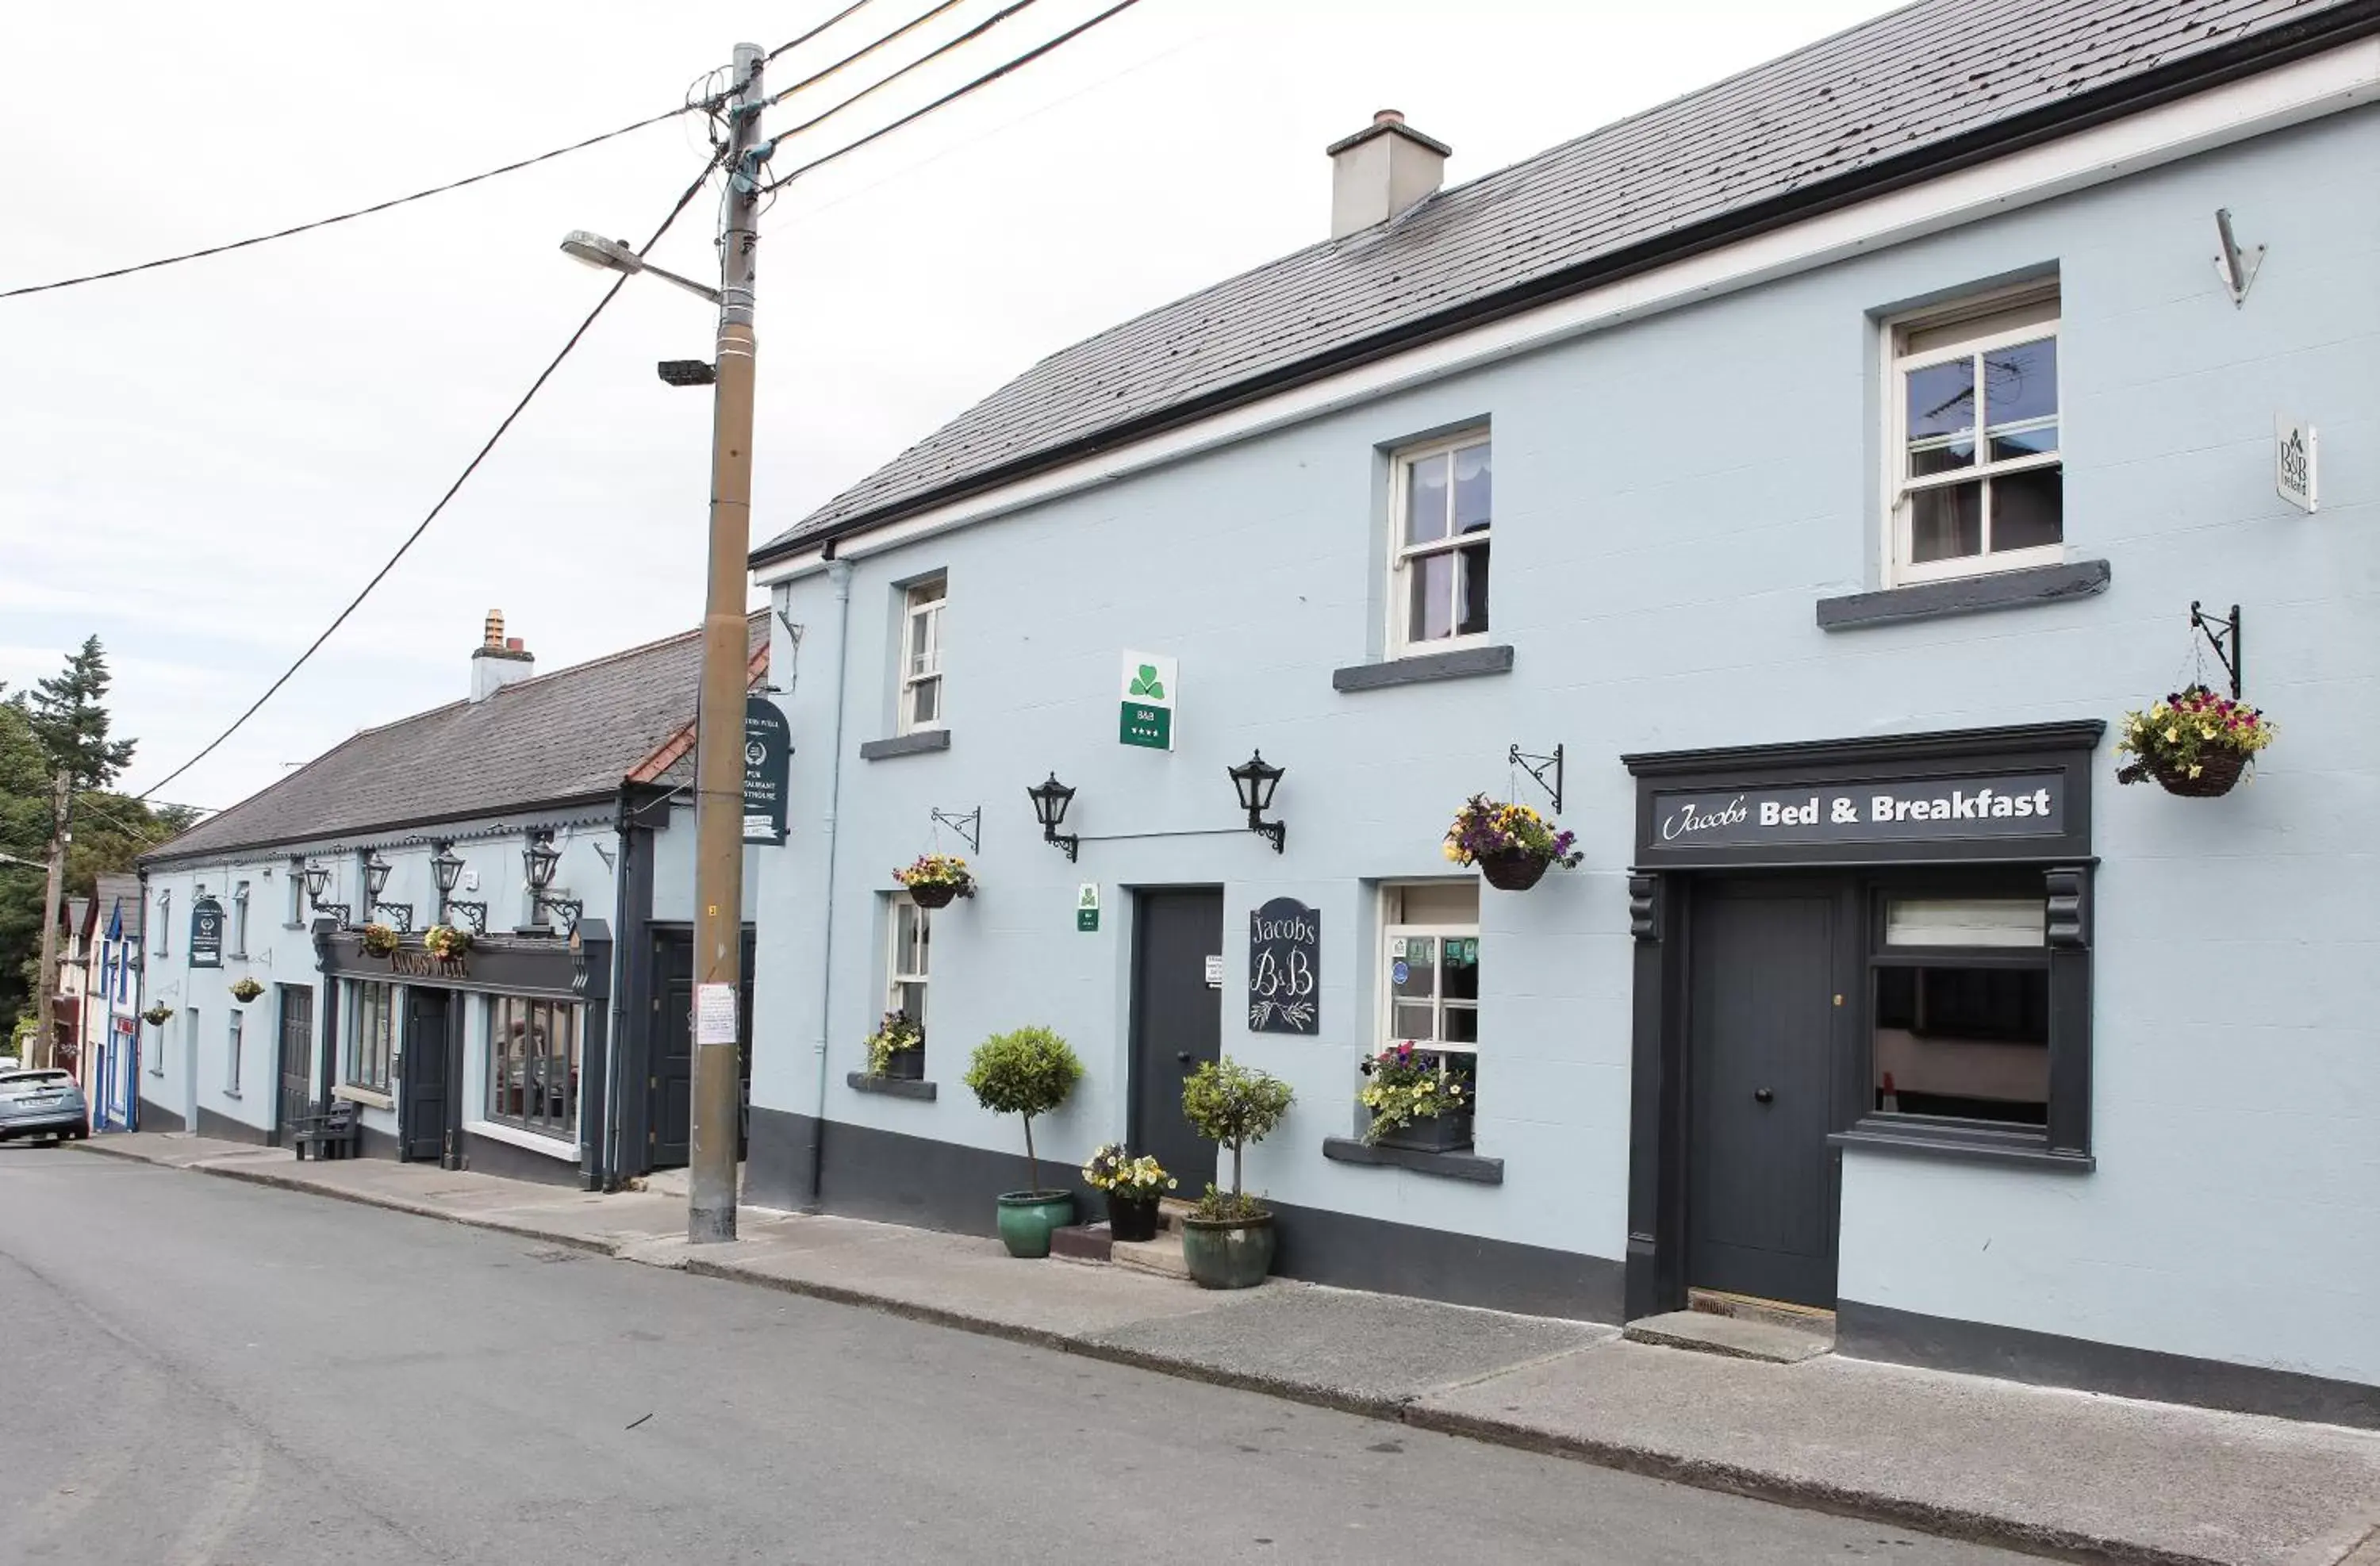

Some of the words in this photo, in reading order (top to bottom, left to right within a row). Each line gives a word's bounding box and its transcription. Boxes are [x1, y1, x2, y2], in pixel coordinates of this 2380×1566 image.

[1662, 795, 1749, 839] Jacob's
[1760, 797, 1819, 827] Bed
[1831, 797, 1859, 823] &
[1871, 788, 2051, 822] Breakfast
